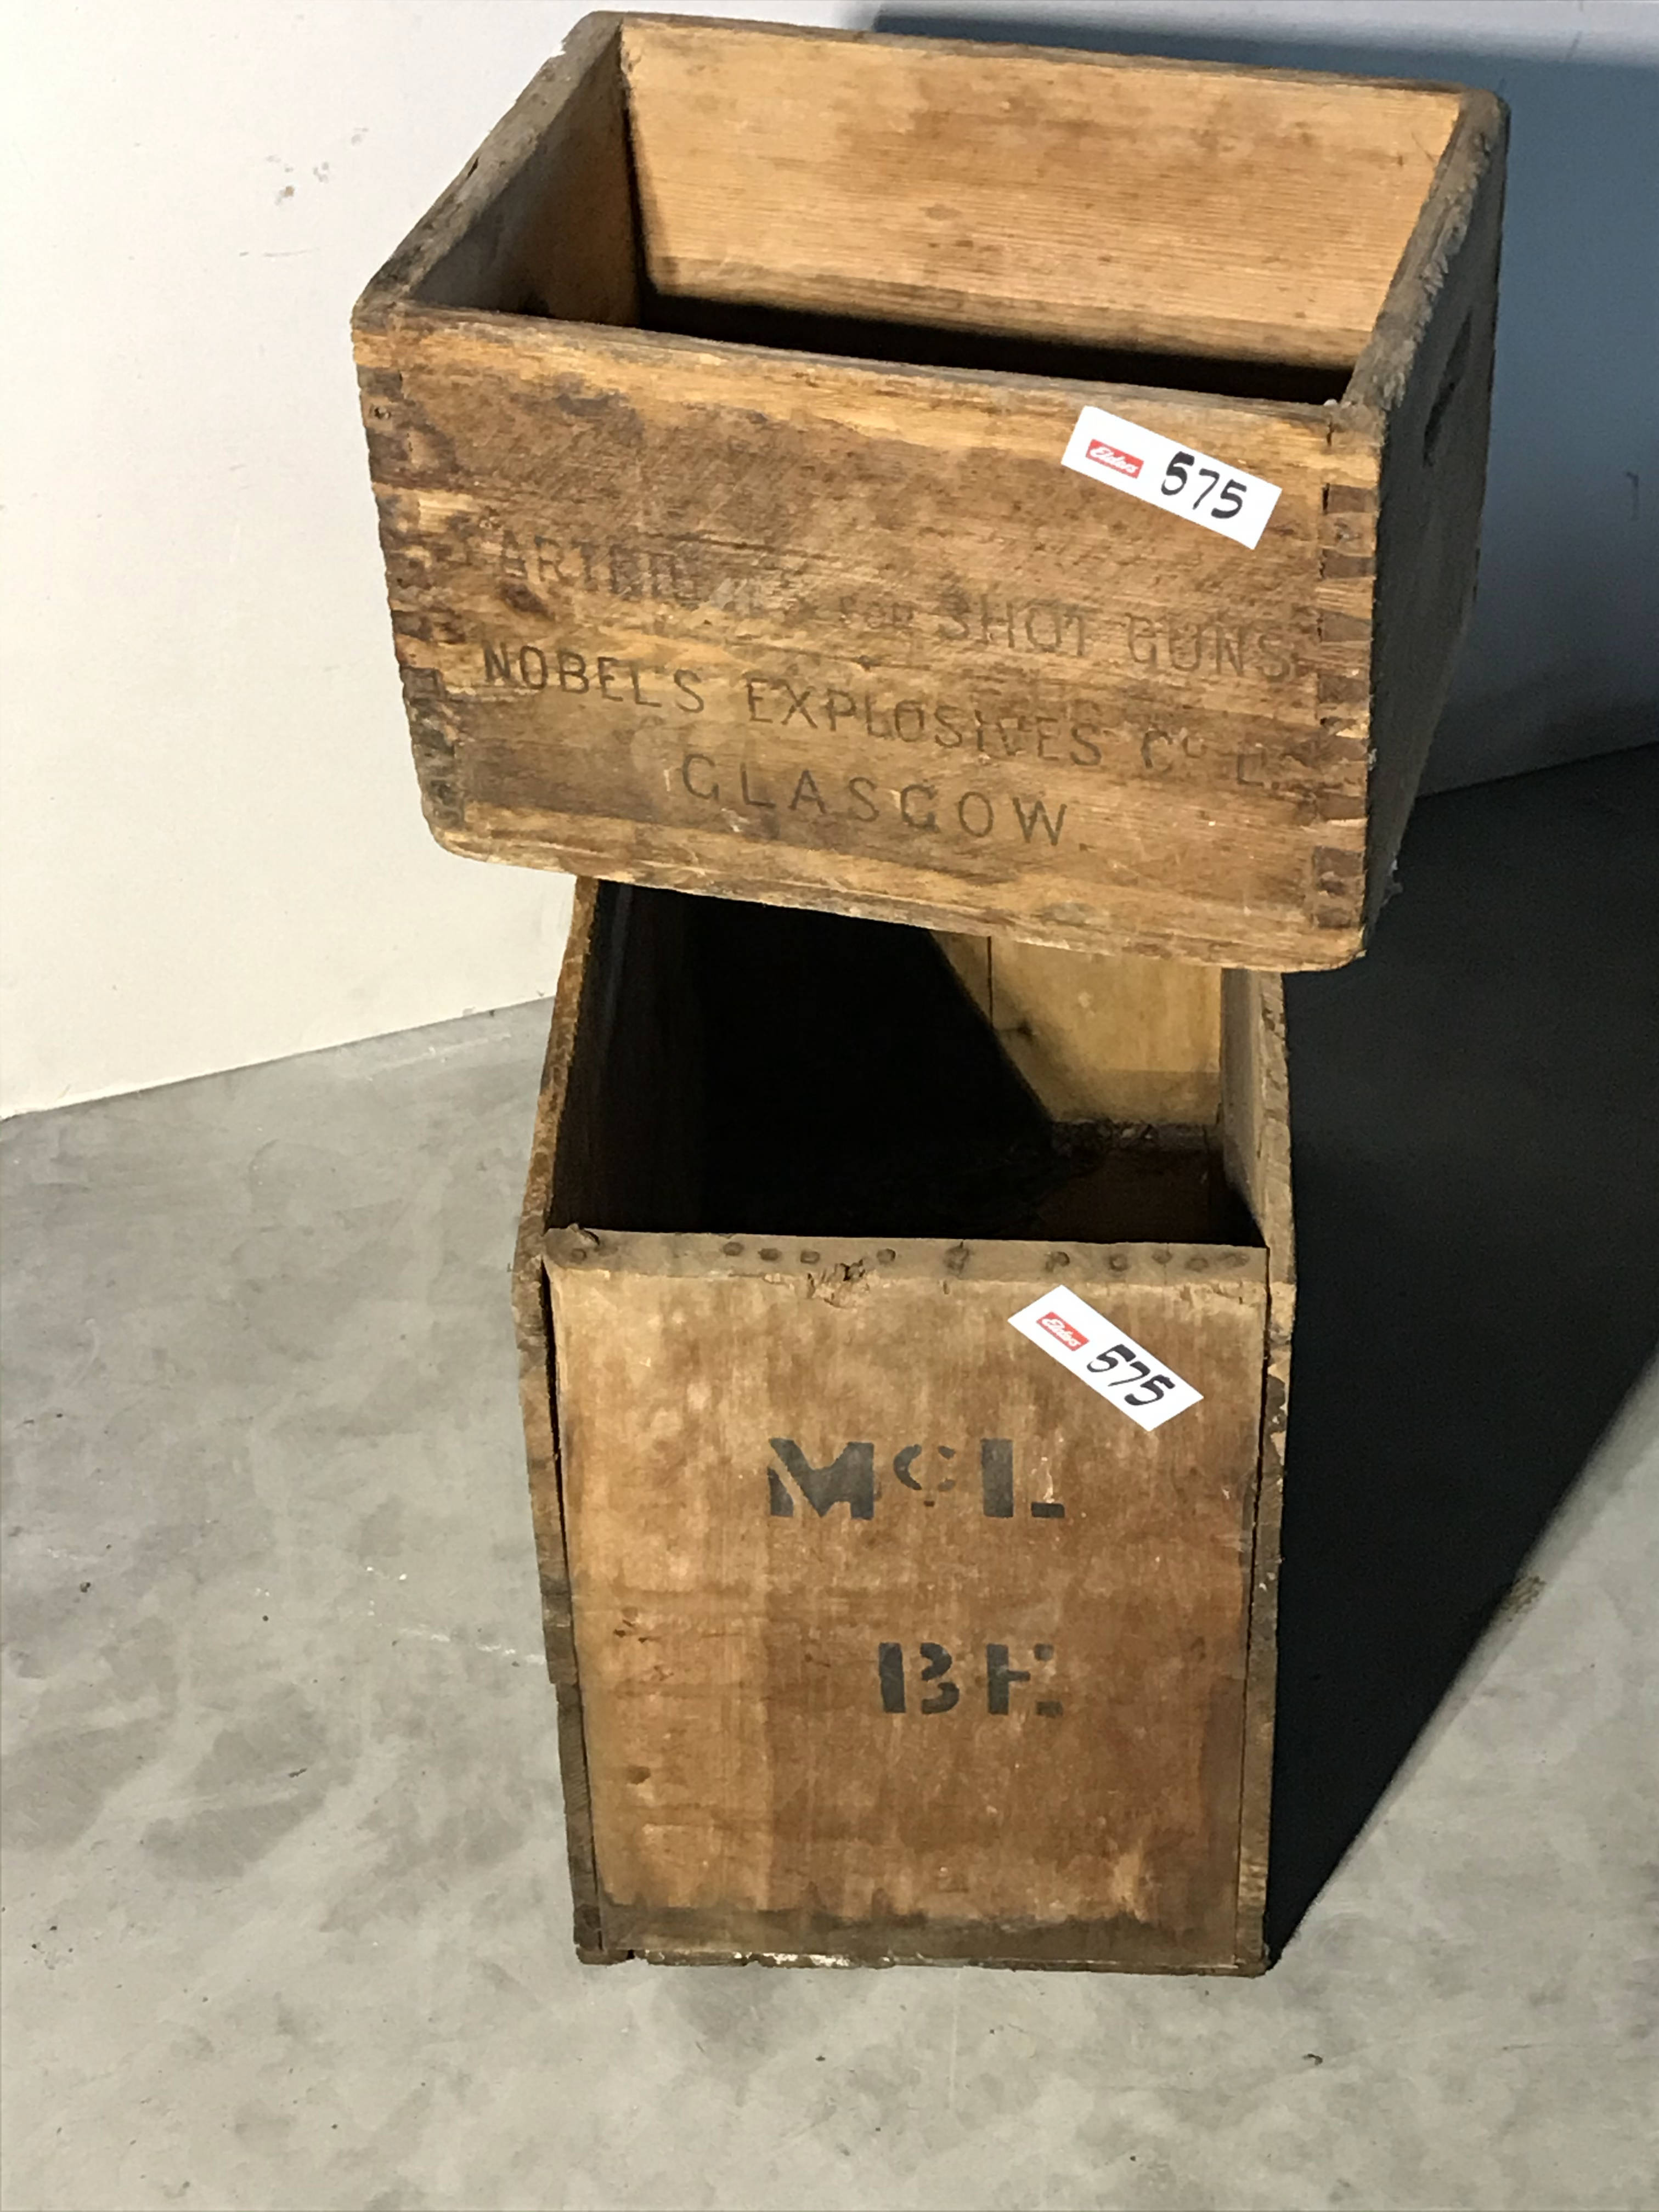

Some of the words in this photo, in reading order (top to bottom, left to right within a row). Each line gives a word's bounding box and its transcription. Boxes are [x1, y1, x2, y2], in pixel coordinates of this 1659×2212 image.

[1161, 451, 1248, 519] 575
[936, 585, 1097, 657] SHOT
[745, 674, 1102, 768] EXPLOSIVES
[1086, 1344, 1176, 1406] 575
